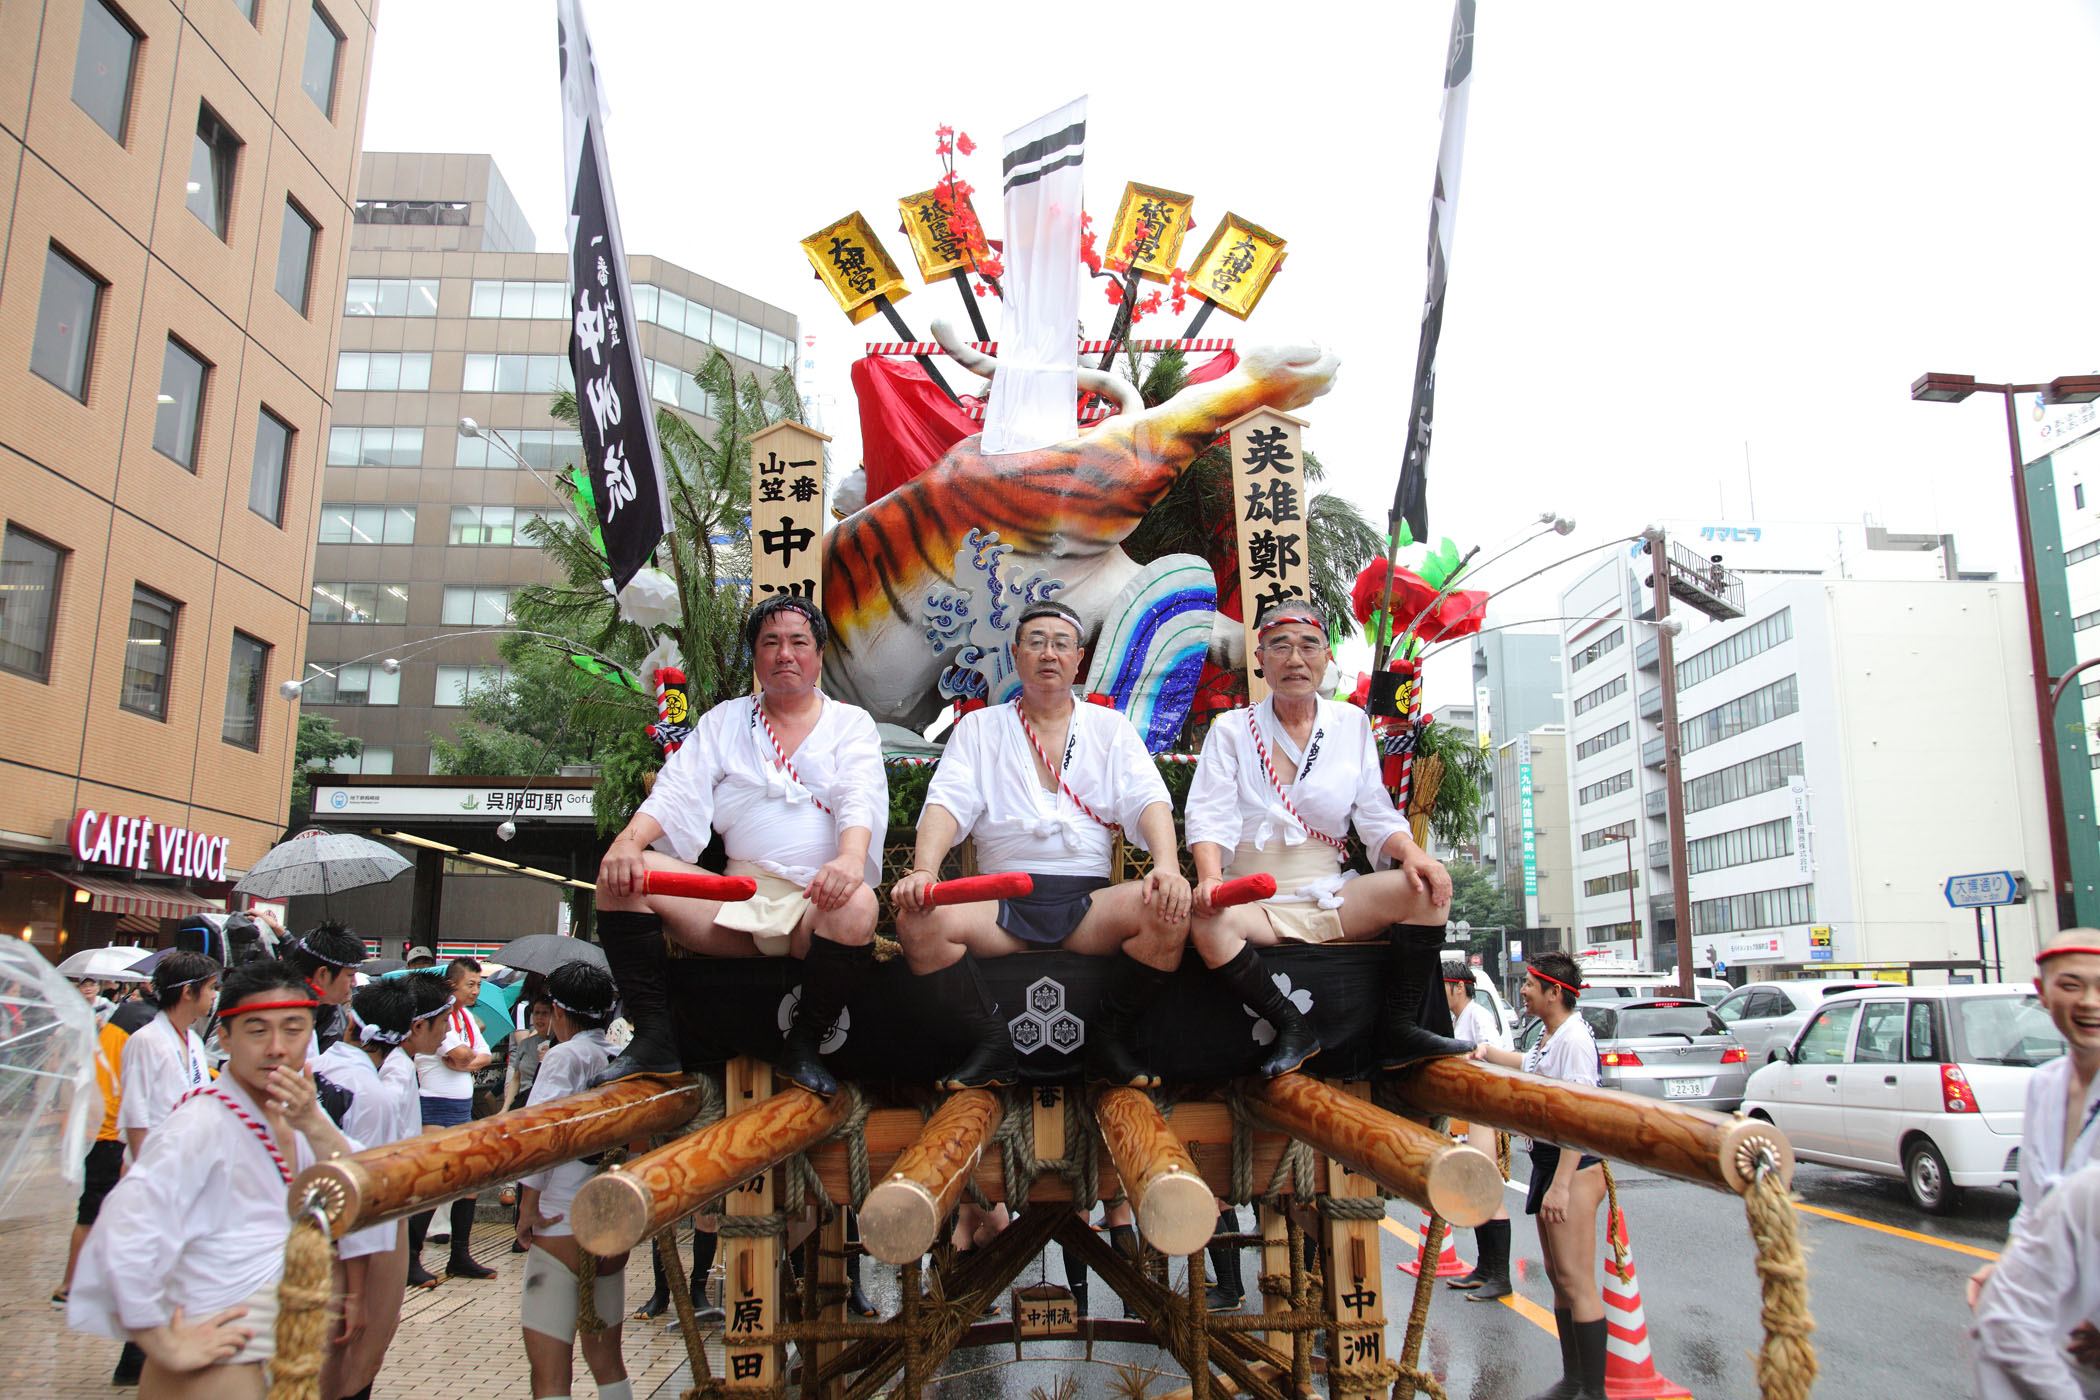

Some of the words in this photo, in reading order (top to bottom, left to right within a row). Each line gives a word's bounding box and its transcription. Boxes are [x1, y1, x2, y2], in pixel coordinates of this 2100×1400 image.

[827, 236, 876, 295] 大神宮
[1211, 234, 1257, 294] 大神宮
[1700, 526, 1762, 542] クマヒラ
[487, 792, 563, 811] 呉服町駅
[1520, 774, 1536, 853] 九州外国語学院
[158, 824, 230, 882] VELOCE
[1955, 877, 2002, 895] 大博通り
[731, 1298, 764, 1381] 原田
[1027, 1306, 1073, 1329] 中洲流
[1340, 1284, 1380, 1367] 中洲
